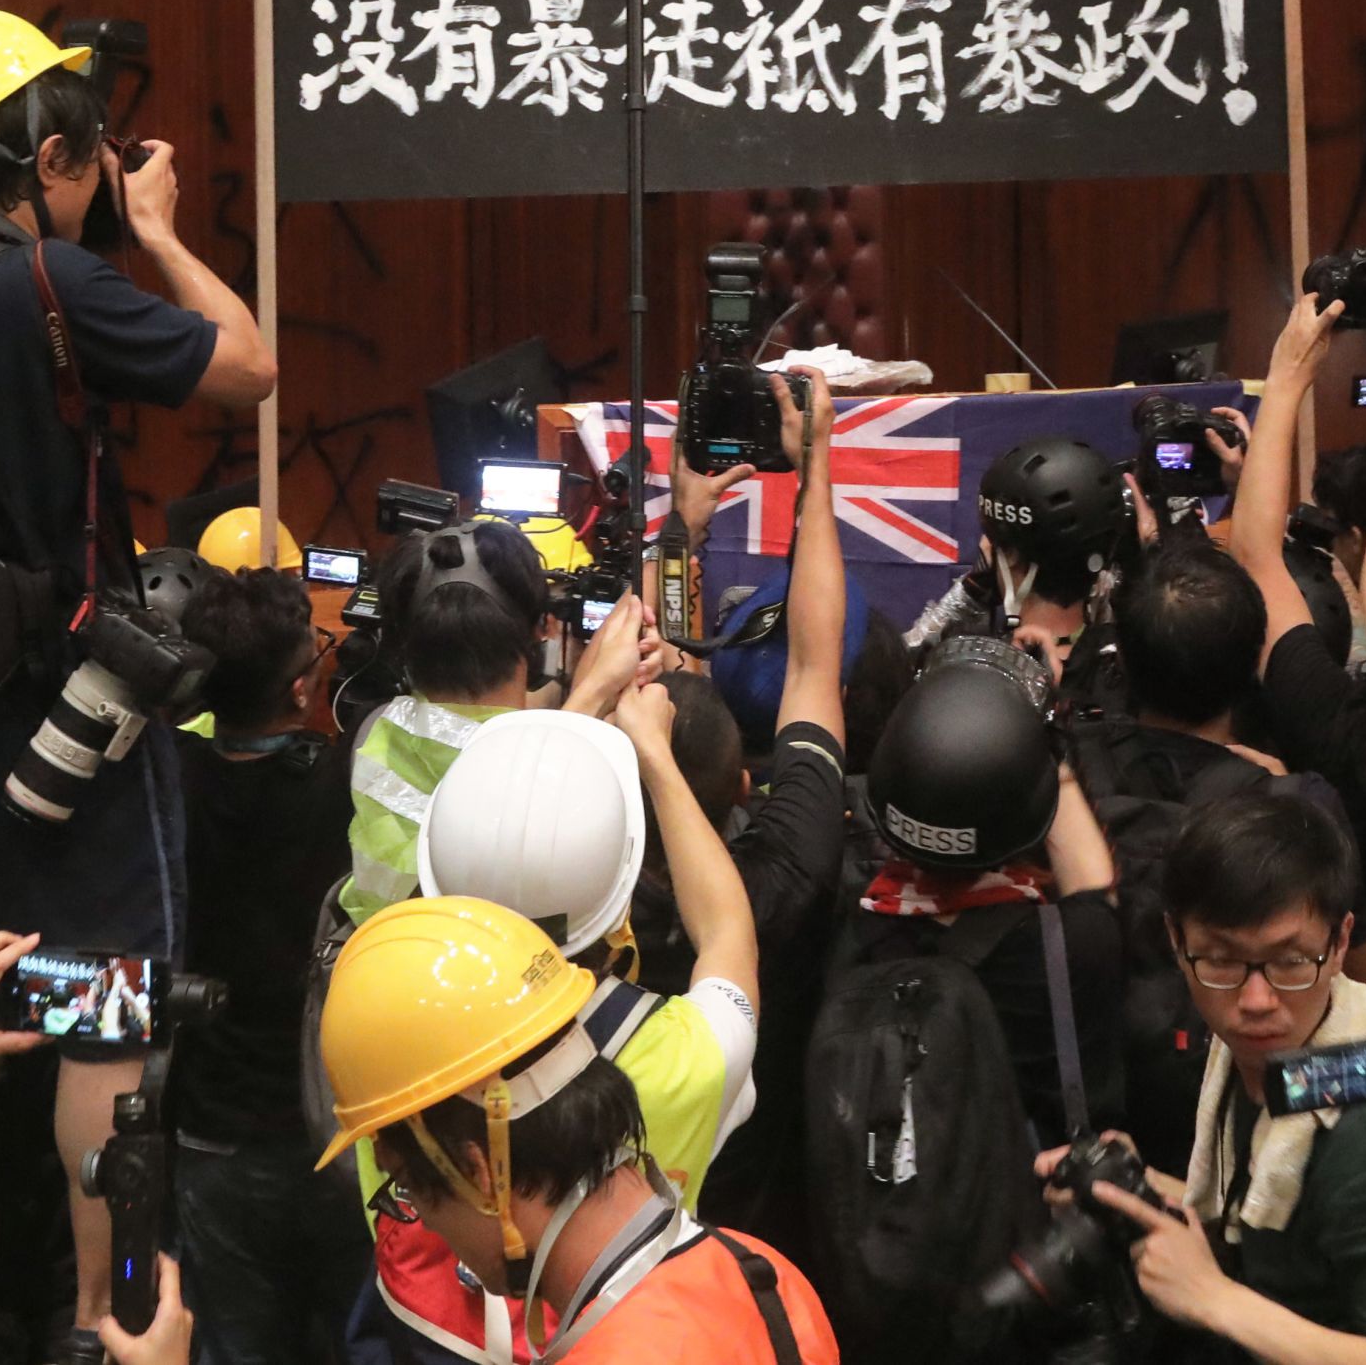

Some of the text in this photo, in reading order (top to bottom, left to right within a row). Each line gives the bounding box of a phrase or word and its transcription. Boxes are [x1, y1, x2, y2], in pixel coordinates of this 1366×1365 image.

[46, 311, 68, 367] Canon
[978, 494, 1033, 525] PRESS
[665, 578, 683, 623] NPS
[889, 808, 974, 852] PRESS
